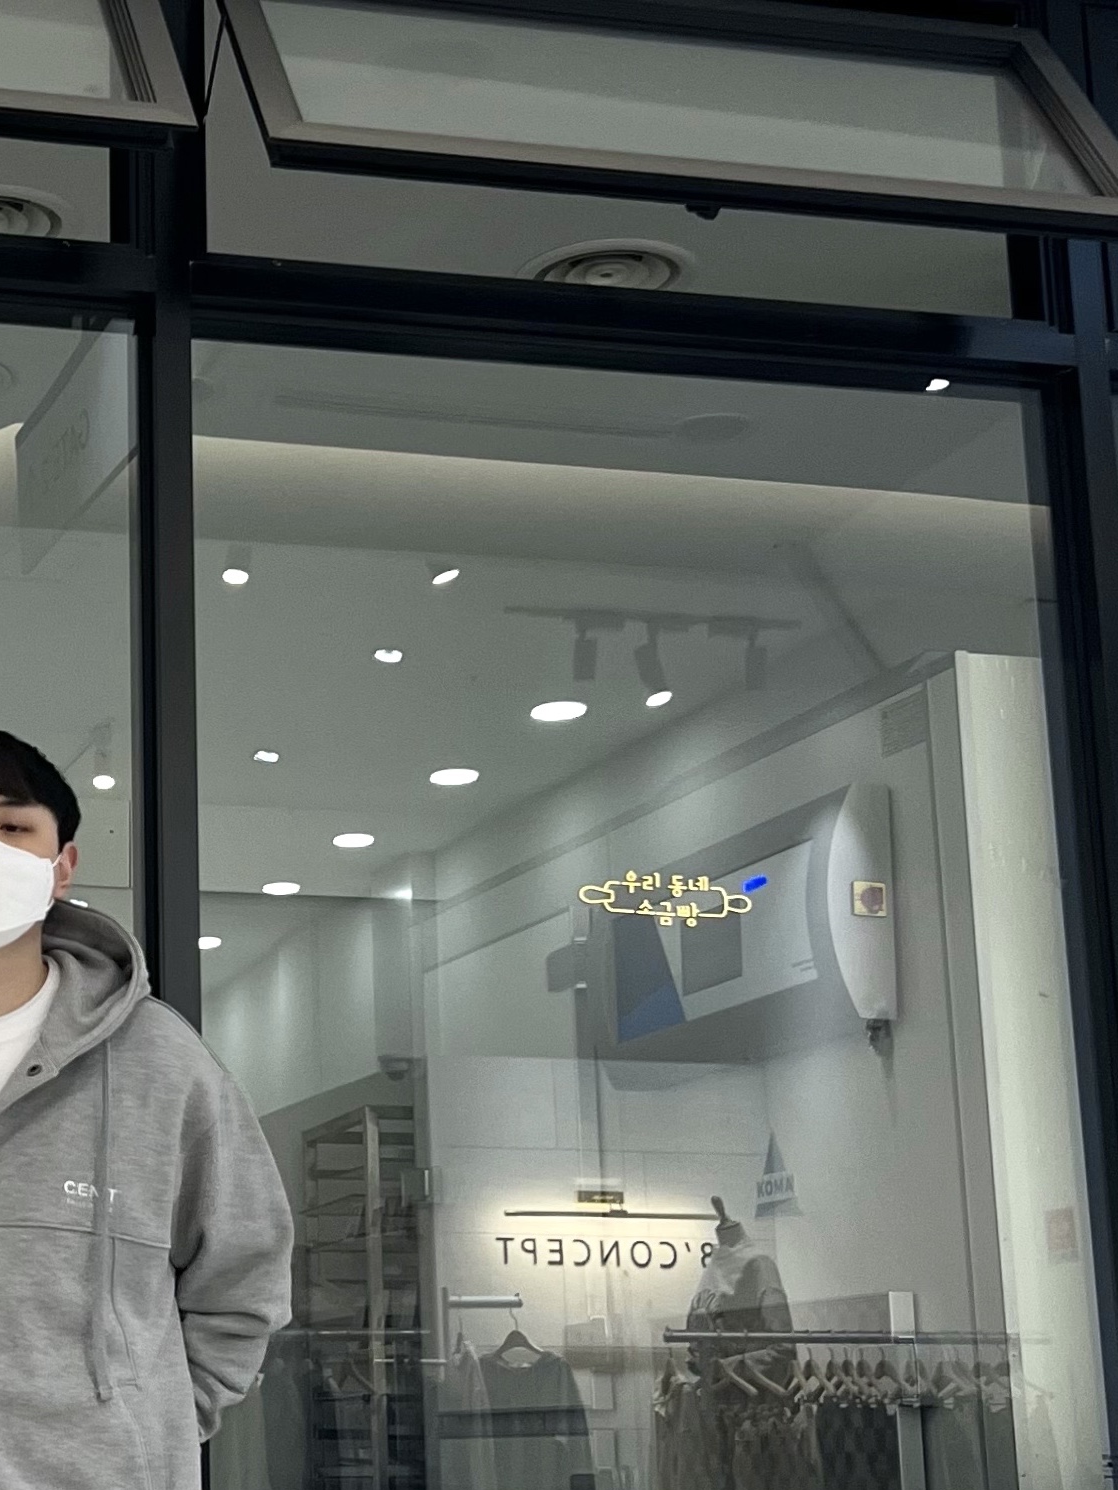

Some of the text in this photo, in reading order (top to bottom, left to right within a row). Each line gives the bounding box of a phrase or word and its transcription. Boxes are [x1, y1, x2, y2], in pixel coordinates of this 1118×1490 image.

[621, 870, 710, 898] 우리 동네
[635, 899, 700, 928] 소금빵
